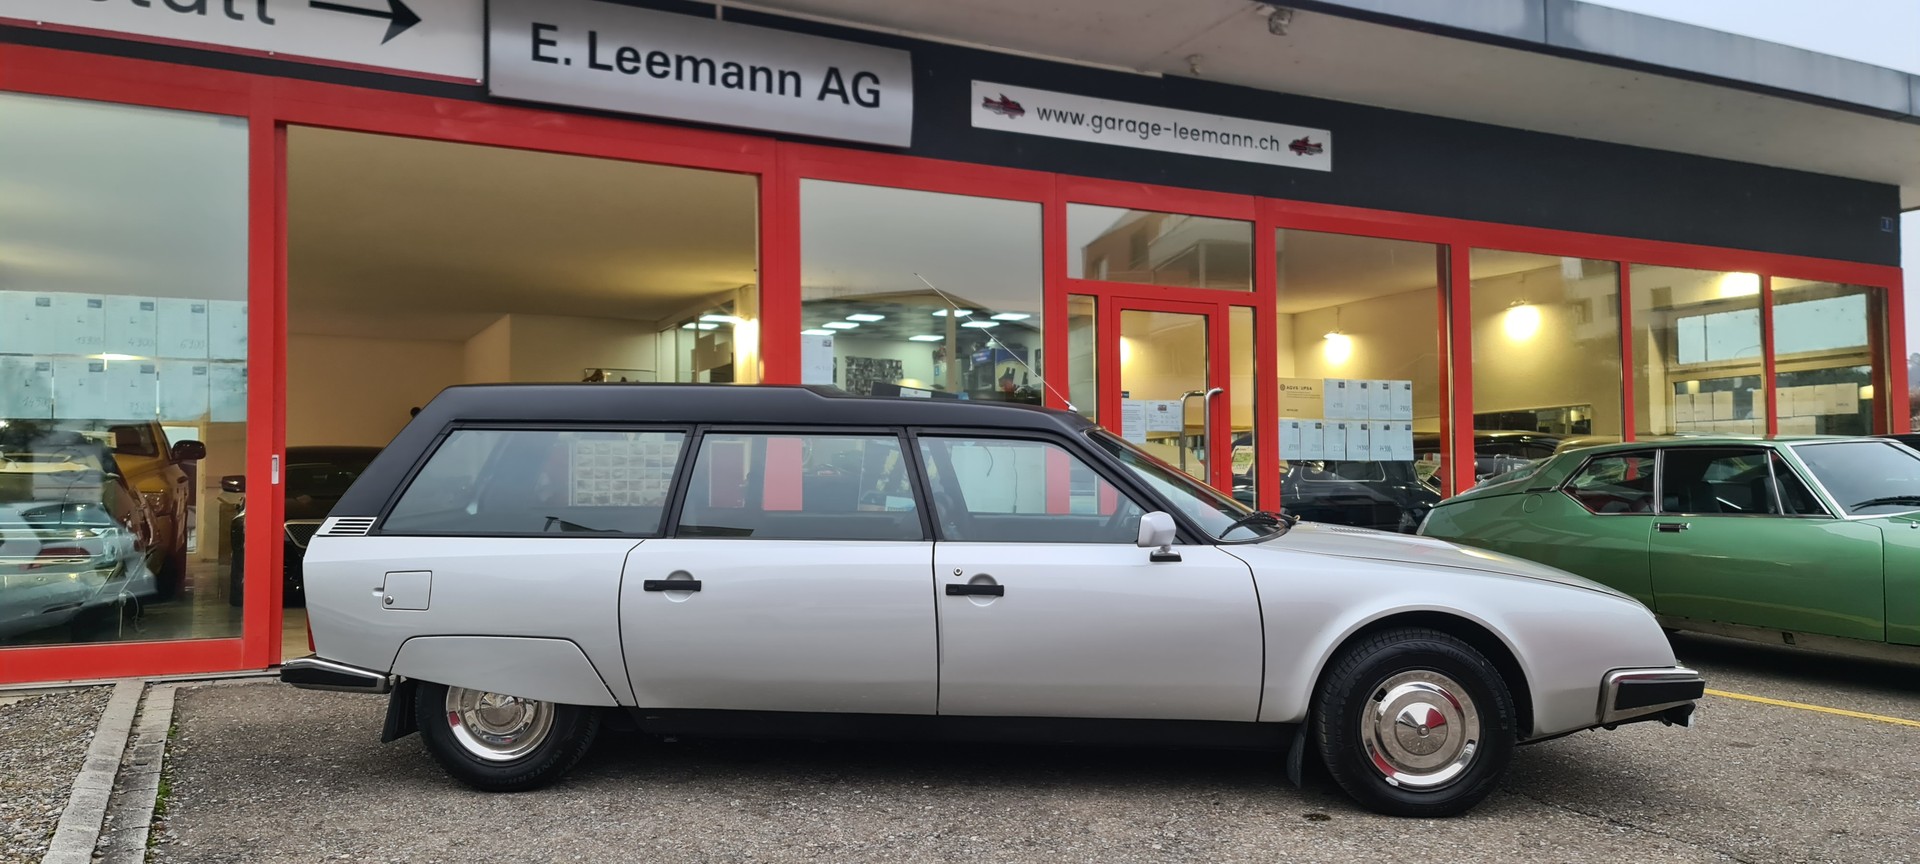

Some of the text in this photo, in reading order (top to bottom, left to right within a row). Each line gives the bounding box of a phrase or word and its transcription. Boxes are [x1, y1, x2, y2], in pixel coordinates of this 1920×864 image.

[531, 22, 881, 109] E. Leemann AG
[1036, 105, 1280, 152] www.garage-leemann.ch
